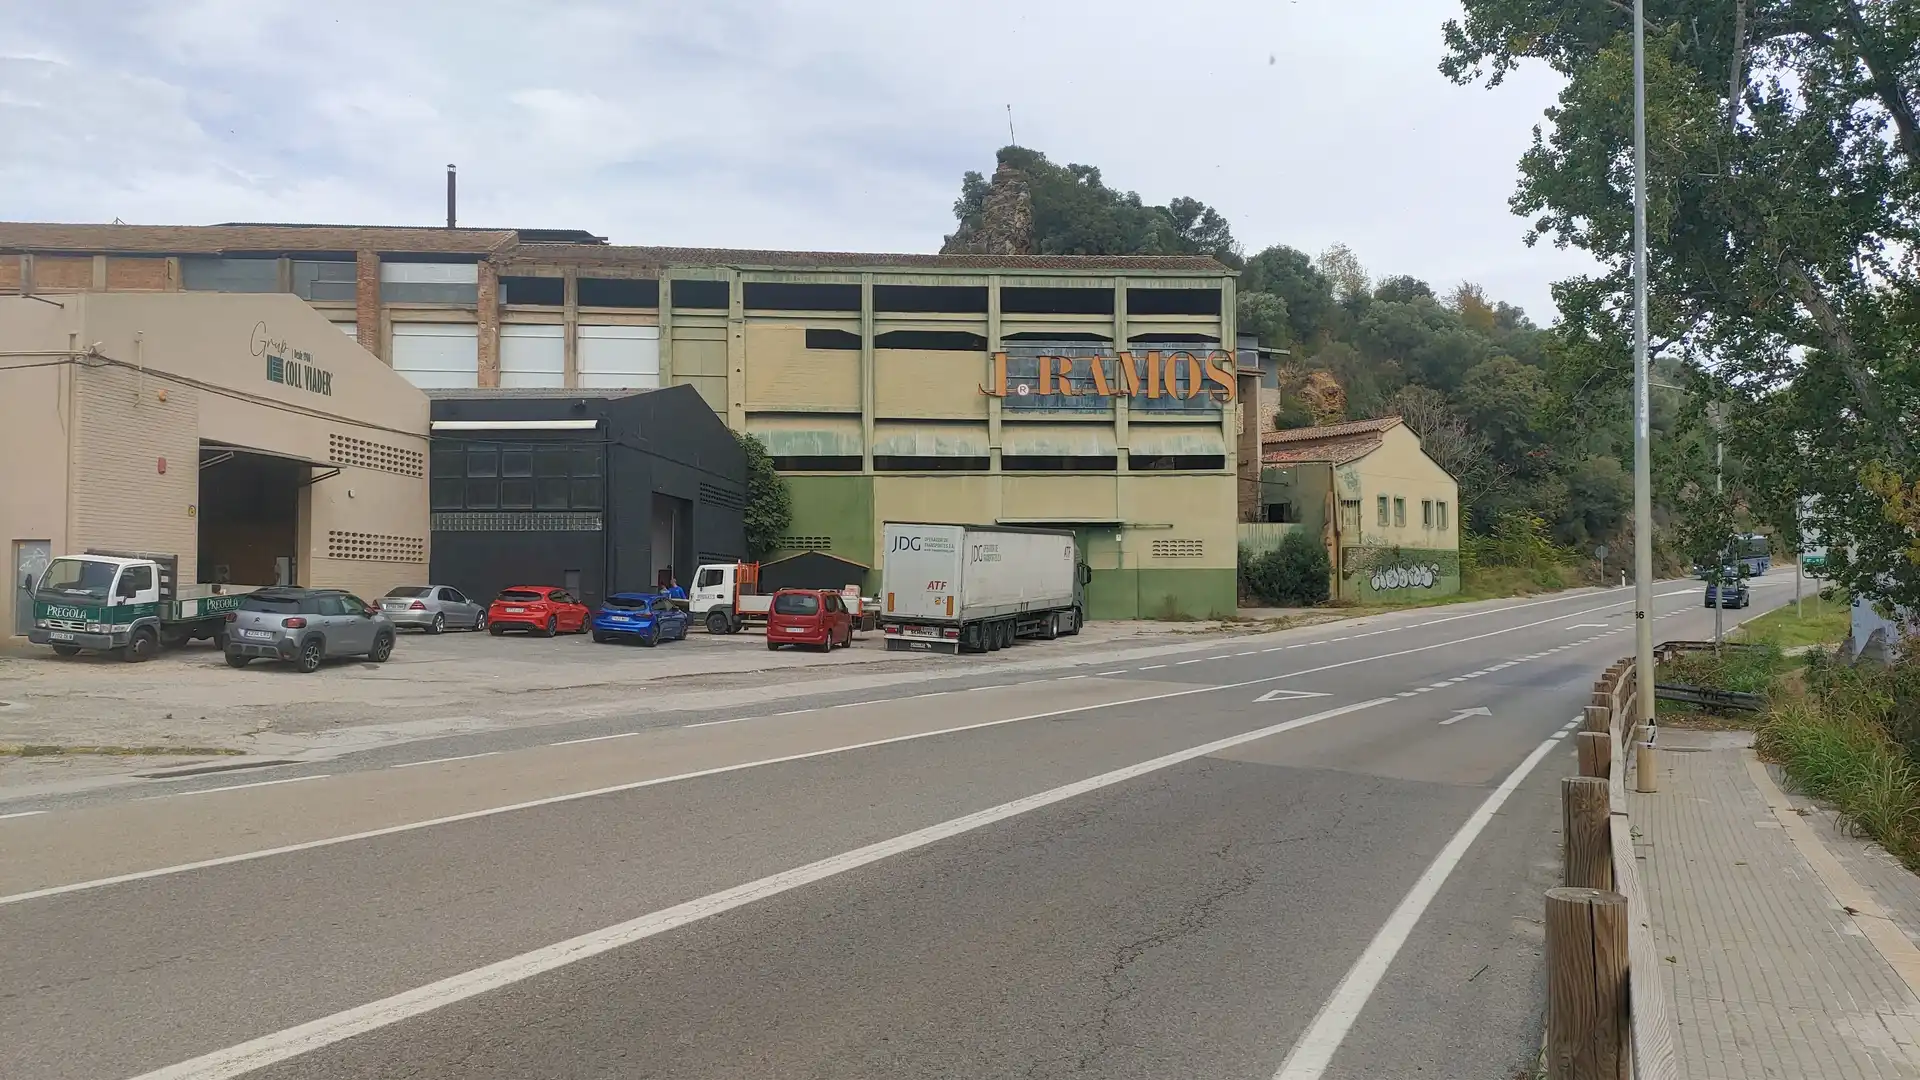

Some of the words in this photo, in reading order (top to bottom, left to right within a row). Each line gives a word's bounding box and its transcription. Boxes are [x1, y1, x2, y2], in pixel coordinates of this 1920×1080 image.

[250, 321, 289, 358] Grup
[285, 360, 302, 389] COLL
[304, 365, 332, 397] VIADER
[1036, 349, 1236, 403] RAMOS
[892, 535, 921, 553] JDG
[970, 544, 983, 566] JDG
[927, 580, 947, 590] ATF
[46, 604, 87, 619] PREGOLA
[206, 598, 239, 611] PREGOLA
